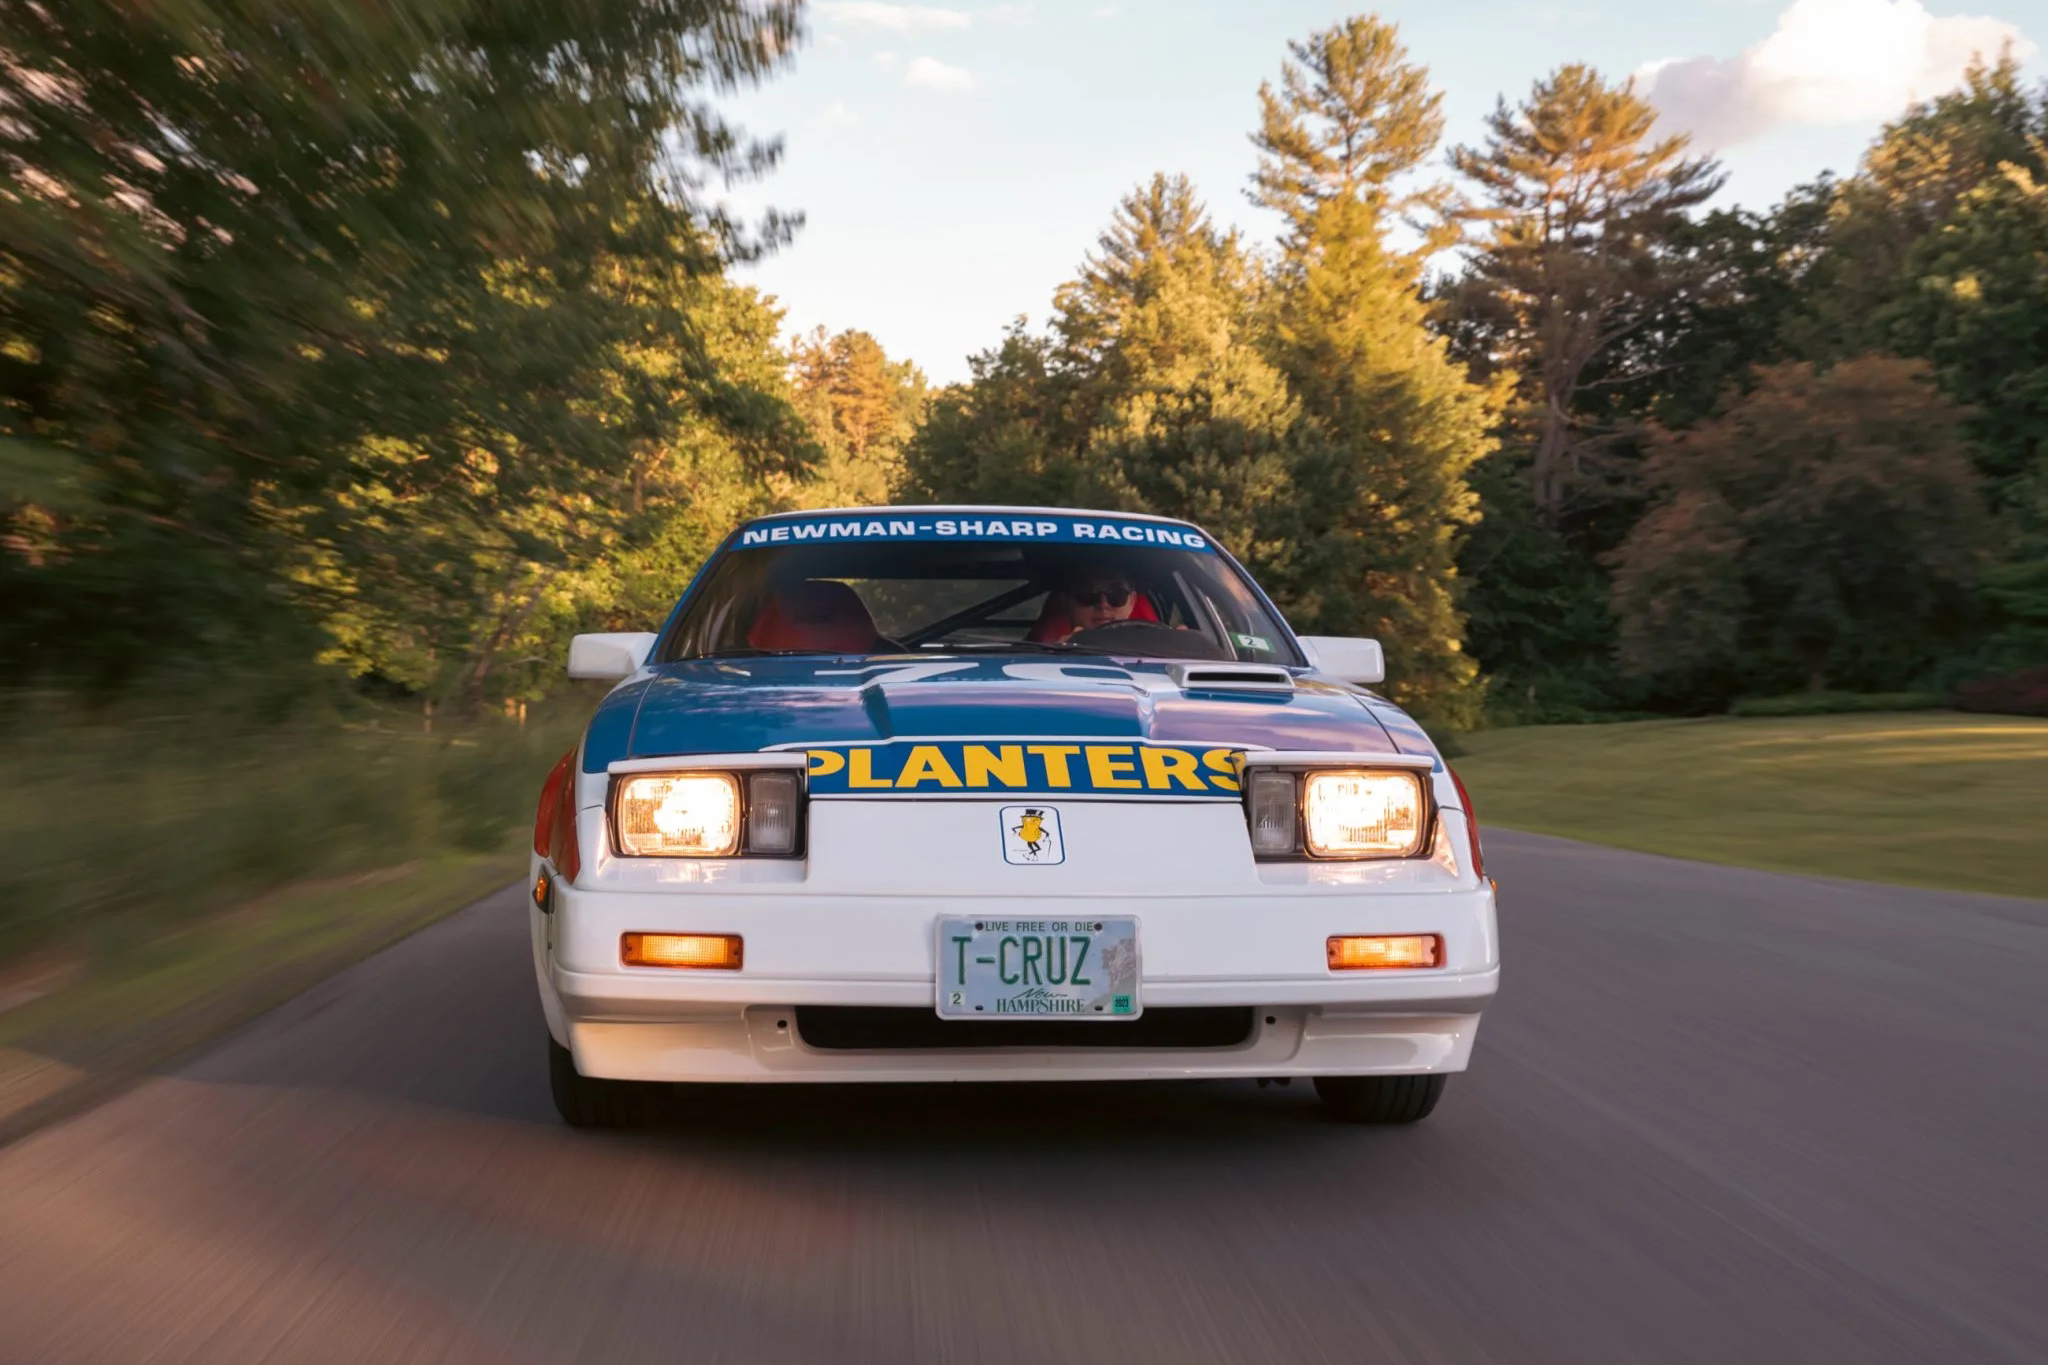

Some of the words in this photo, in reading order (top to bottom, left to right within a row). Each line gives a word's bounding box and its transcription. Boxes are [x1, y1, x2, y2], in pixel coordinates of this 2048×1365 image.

[743, 521, 1058, 545] NEWMAN-SHARP
[1073, 523, 1206, 548] RACING
[1244, 637, 1256, 647] 2
[985, 922, 1008, 932] LIVE
[1016, 922, 1045, 932] FREE
[1052, 922, 1068, 932] OR
[1075, 922, 1093, 932] DIE
[952, 936, 1091, 985] T-CRUZ
[952, 993, 961, 1005] 2
[996, 998, 1085, 1013] HAMPSHIRE
